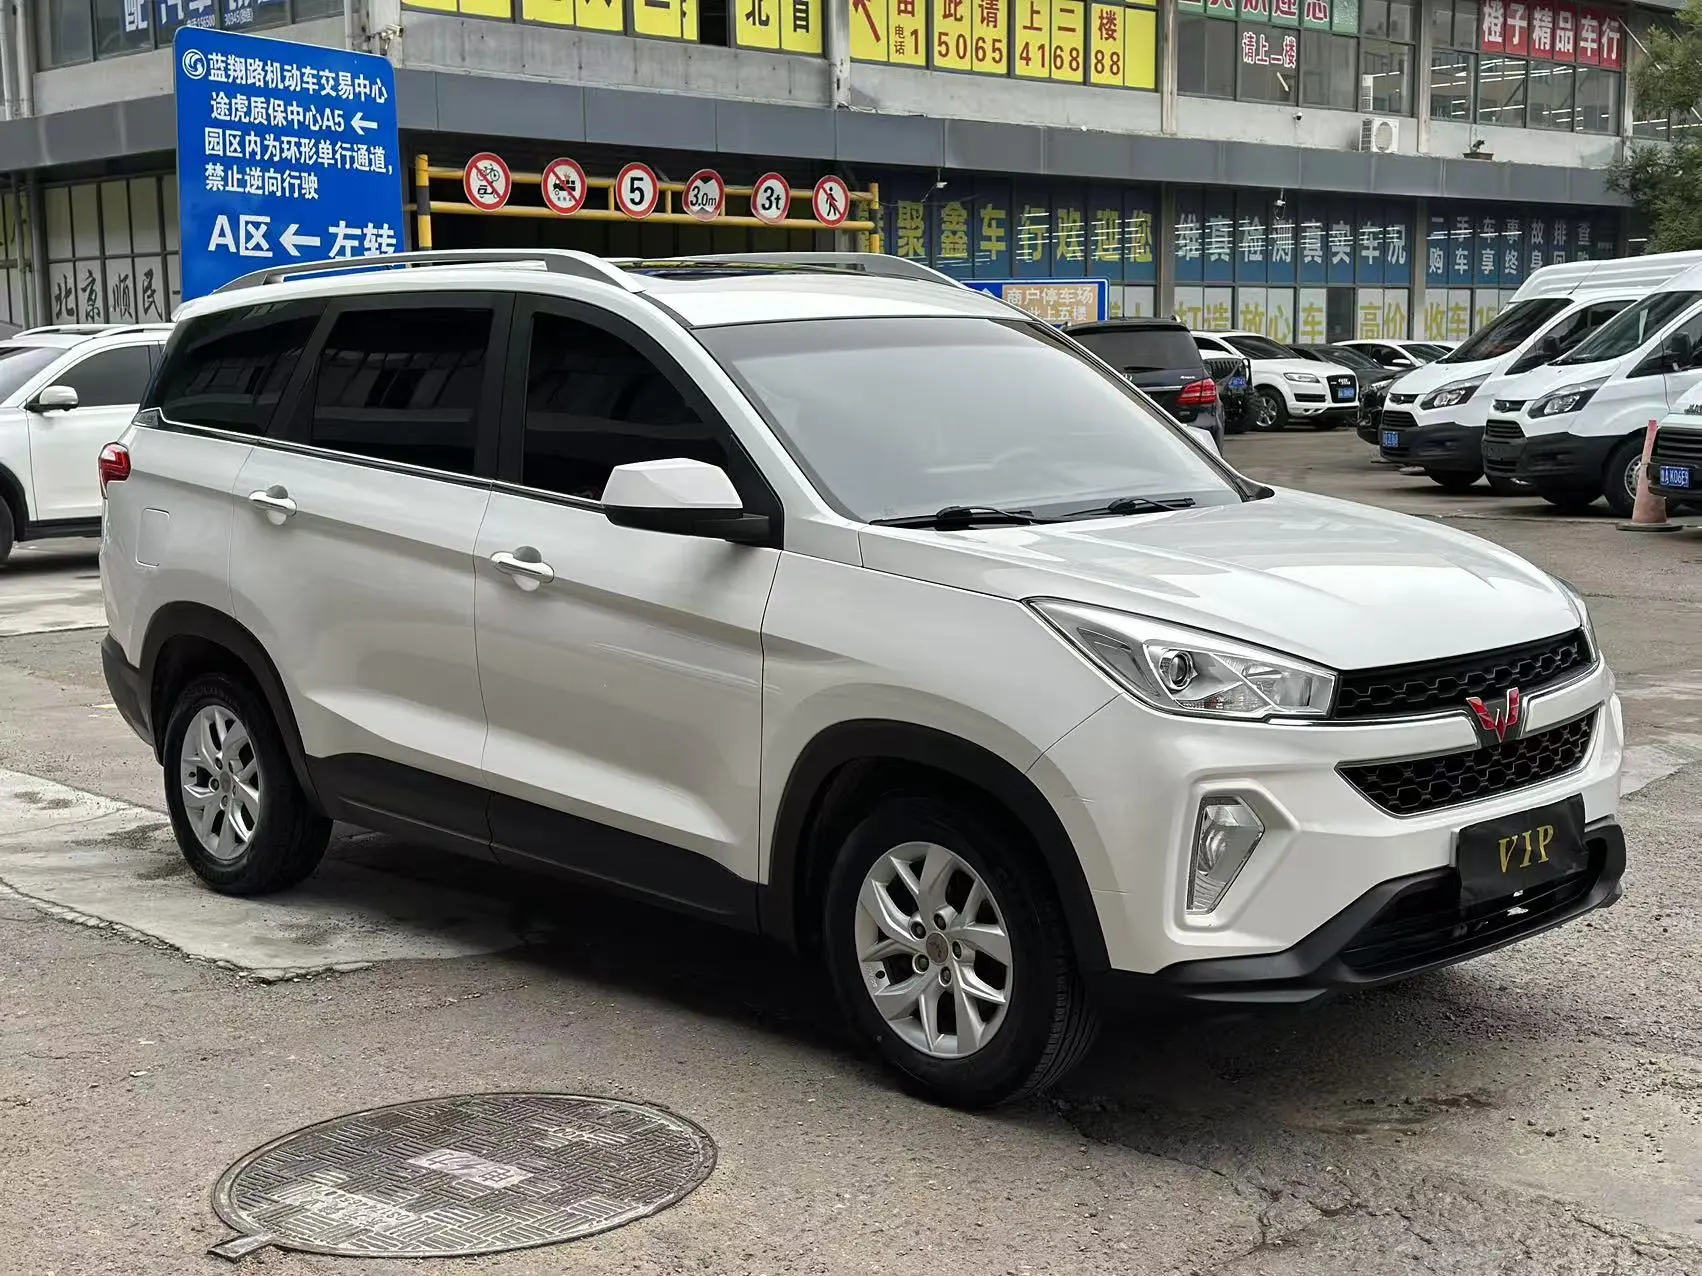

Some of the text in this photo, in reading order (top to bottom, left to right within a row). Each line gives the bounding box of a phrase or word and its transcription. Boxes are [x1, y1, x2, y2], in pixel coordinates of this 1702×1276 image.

[894, 24, 905, 56] 电话
[1483, 0, 1620, 59] 橙子精品车行
[208, 53, 388, 103] 蓝翔路机动车交易中心
[211, 92, 344, 131] 途虎质保中心A5
[205, 162, 318, 199] 禁止逆向行驶
[629, 177, 645, 205] 5
[690, 185, 717, 207] 3.0m
[762, 185, 781, 211] 3t
[208, 215, 396, 259] A区 左转
[1007, 286, 1093, 306] 商户停车场
[1498, 825, 1553, 872] VIP
